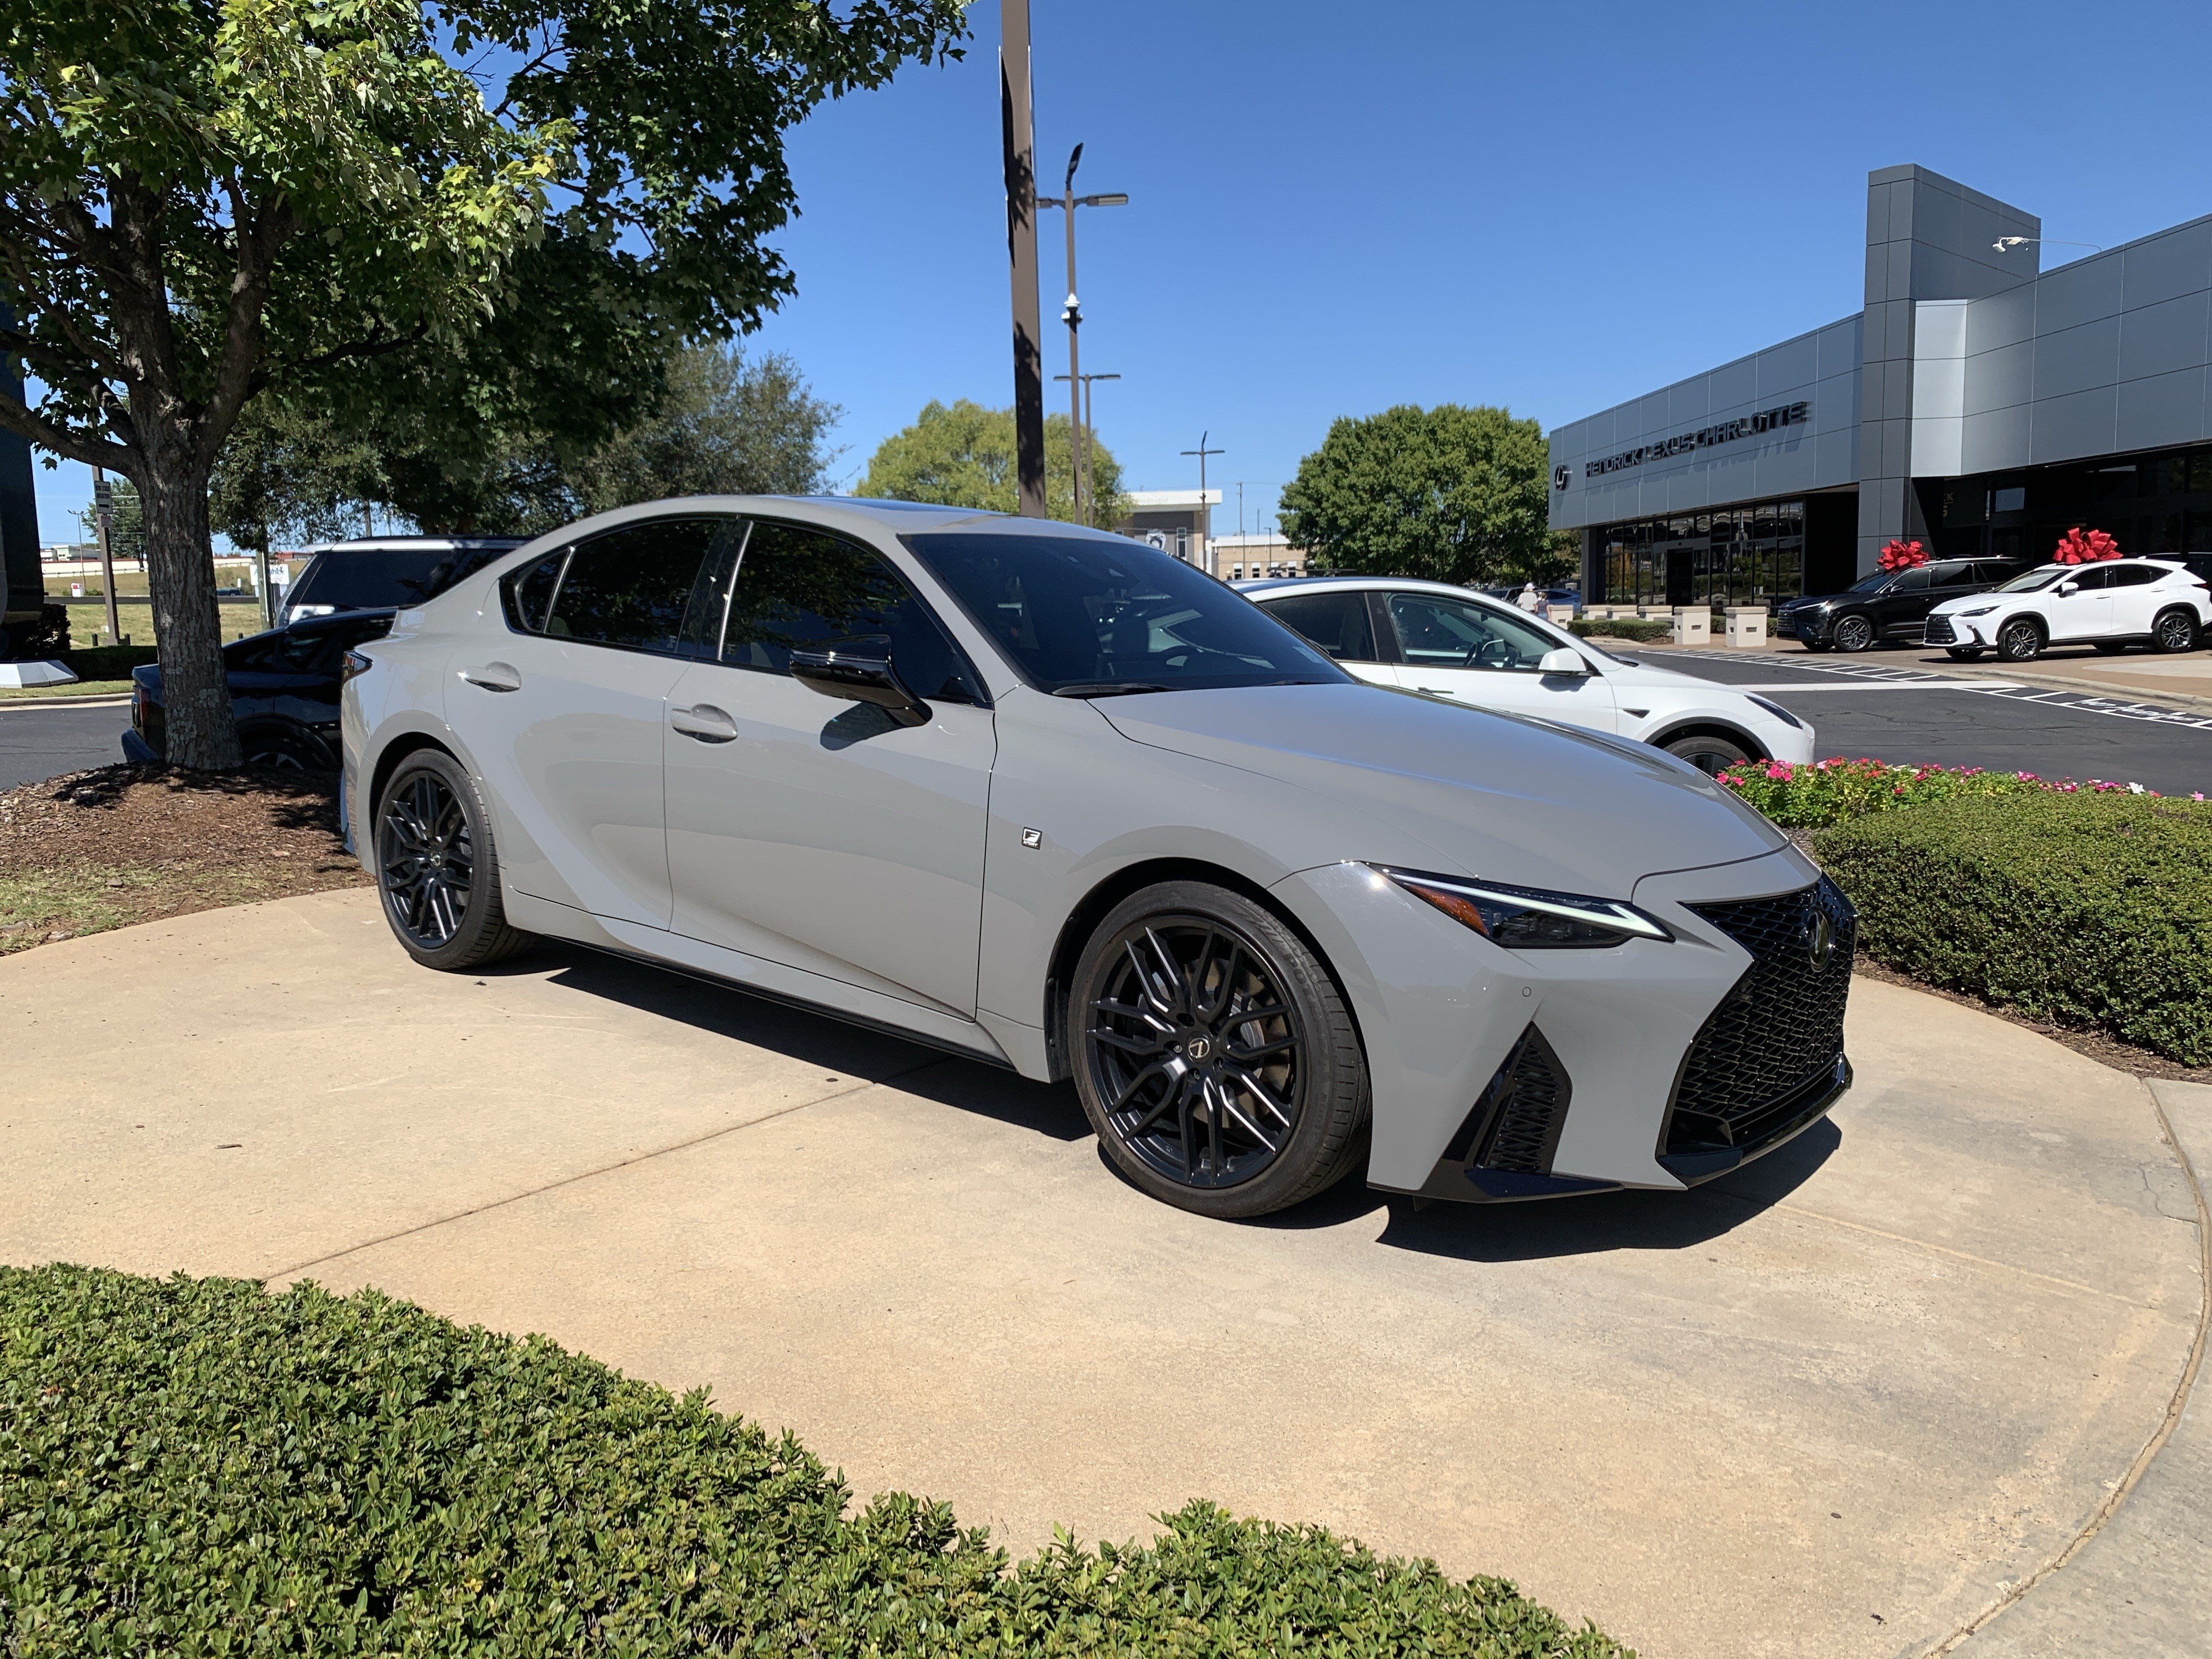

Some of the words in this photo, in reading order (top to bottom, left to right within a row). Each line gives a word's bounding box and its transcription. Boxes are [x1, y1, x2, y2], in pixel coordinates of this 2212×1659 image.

[1585, 448, 1642, 477] HENDRICK
[1643, 433, 1694, 462] LEXUS
[1694, 401, 1809, 450] CHARLOTTE
